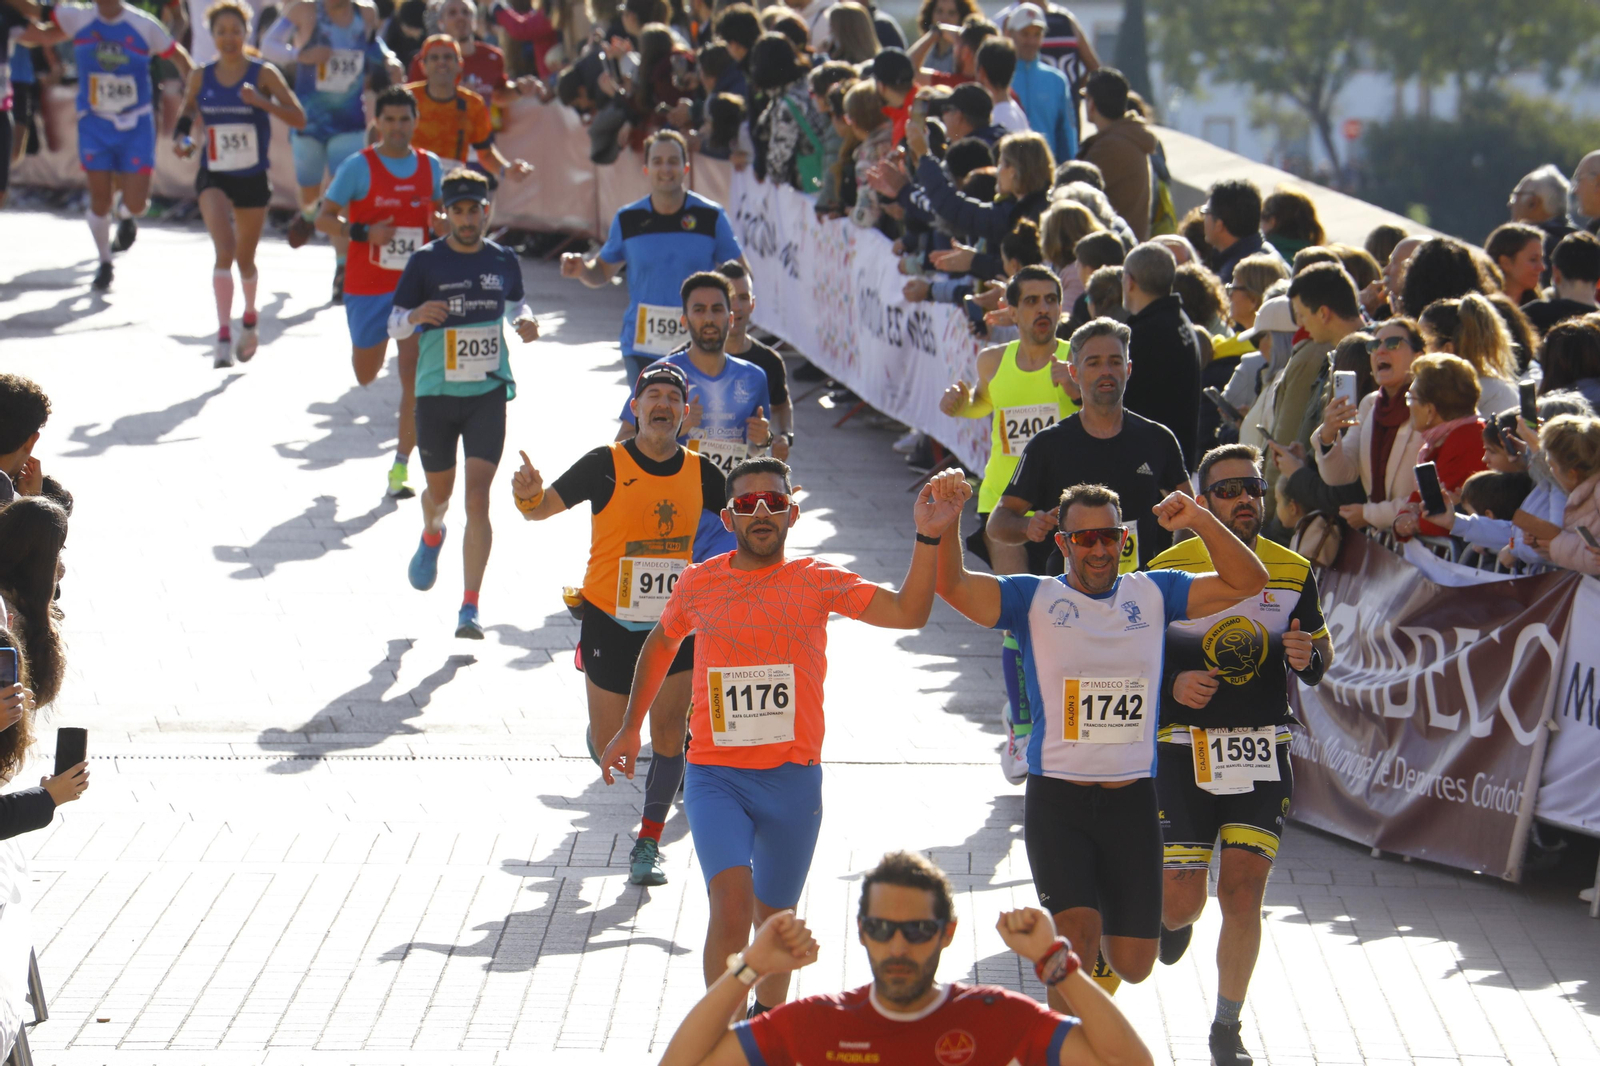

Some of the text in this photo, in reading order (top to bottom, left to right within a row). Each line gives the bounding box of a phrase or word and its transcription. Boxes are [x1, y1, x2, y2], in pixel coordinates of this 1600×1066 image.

[221, 133, 249, 151] 351
[387, 238, 415, 255] 334
[458, 337, 499, 357] 2035
[641, 561, 669, 569] IMDECO
[640, 572, 680, 594] 910
[1212, 617, 1241, 638] ATLETISMO
[732, 670, 766, 679] IMDECO
[1091, 681, 1123, 689] IMDECO
[1230, 675, 1248, 684] RUTE
[726, 683, 789, 712] 1176
[1081, 694, 1143, 720] 1742
[1067, 701, 1075, 727] CAJÓN
[1198, 749, 1206, 771] CAJÓN
[1211, 737, 1272, 762] 1593
[1392, 756, 1468, 803] Deportes
[1471, 772, 1525, 817] Córdob
